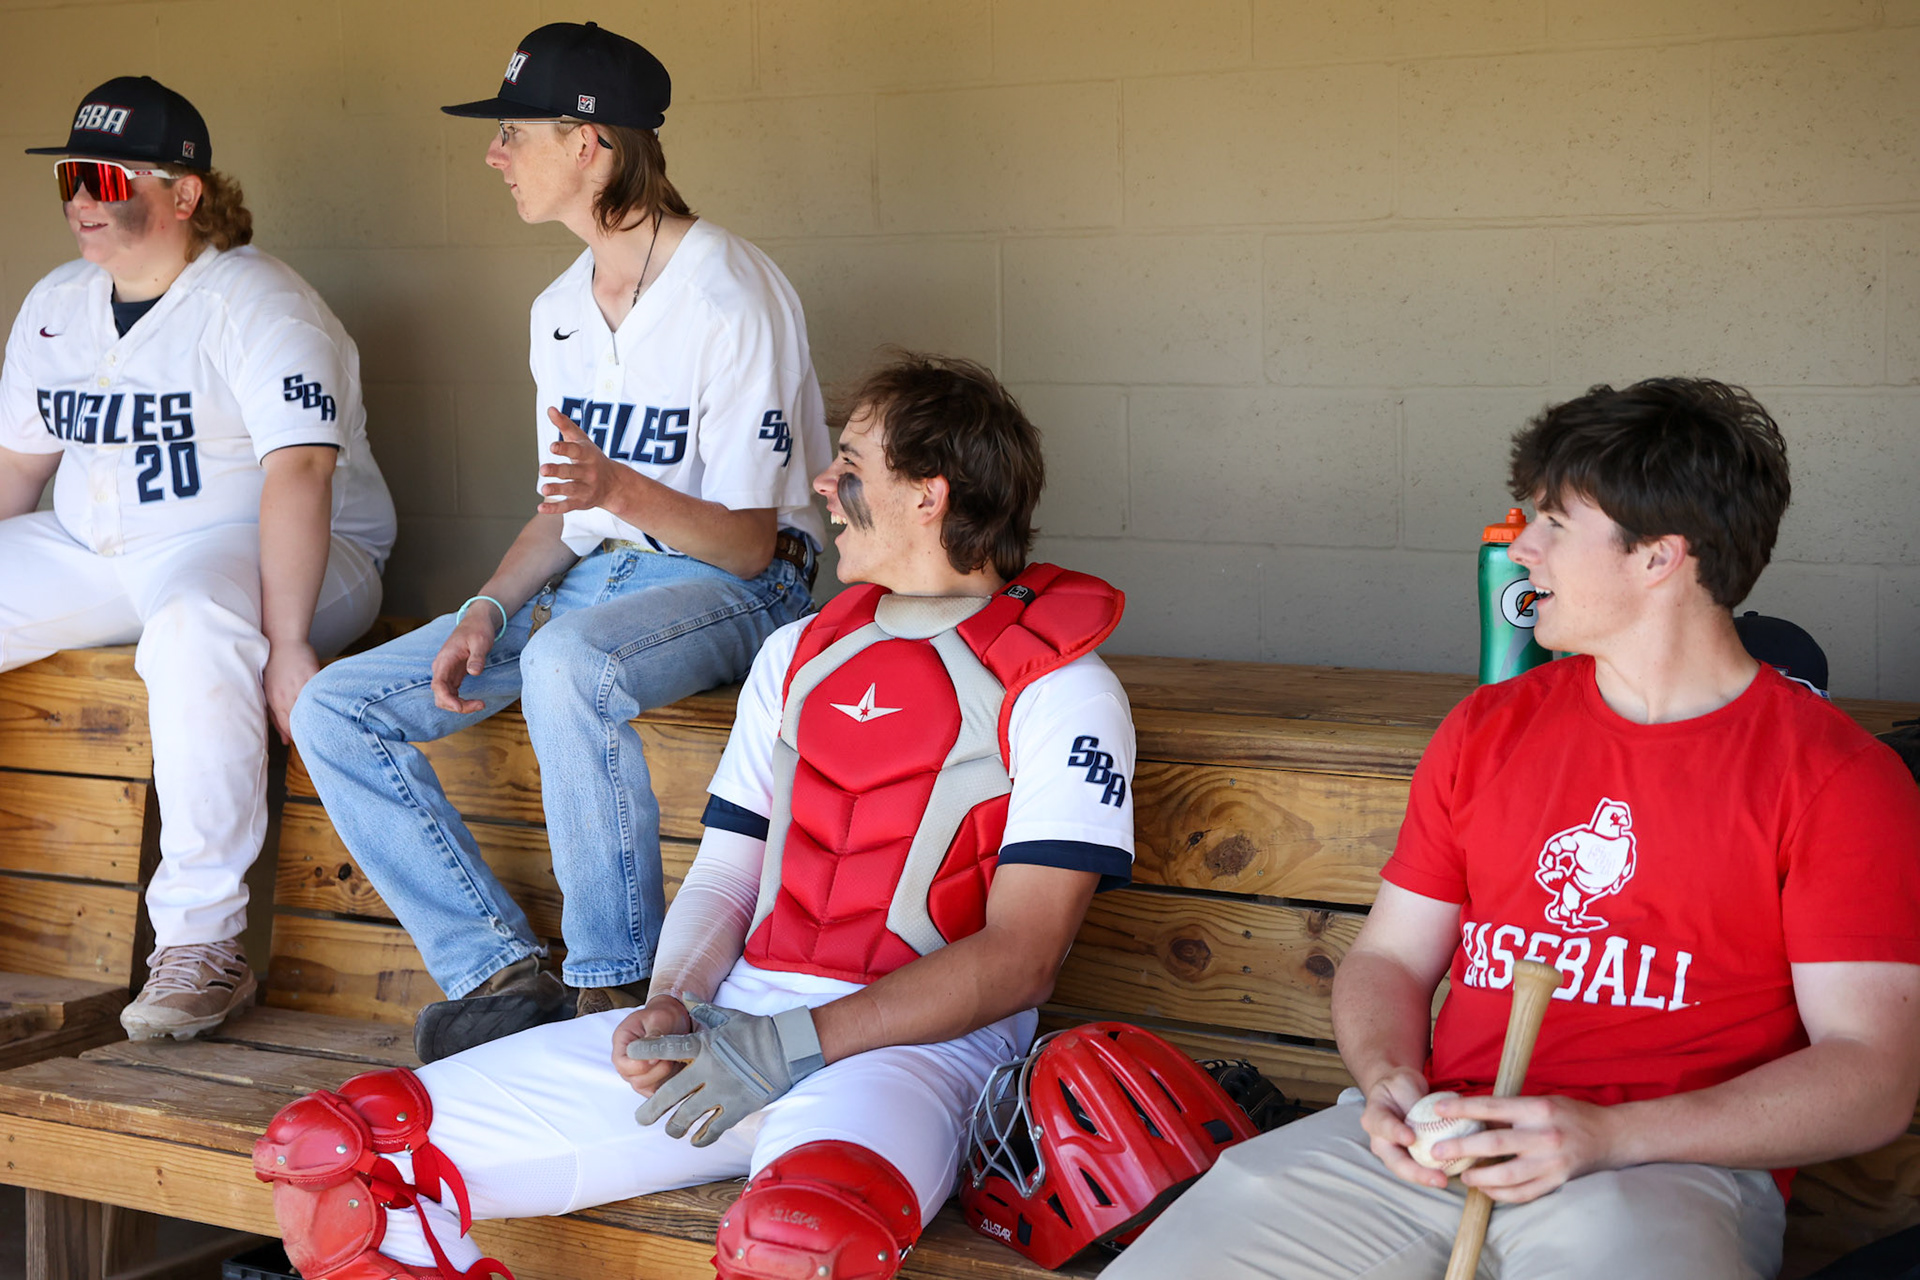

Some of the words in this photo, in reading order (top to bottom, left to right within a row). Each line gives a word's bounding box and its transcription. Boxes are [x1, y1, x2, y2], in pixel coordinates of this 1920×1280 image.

[74, 104, 132, 135] SBA
[36, 388, 195, 444] EAGLES
[283, 373, 336, 422] SBA
[558, 397, 690, 466] EGLES
[135, 441, 202, 504] 20
[1068, 734, 1126, 809] SBA
